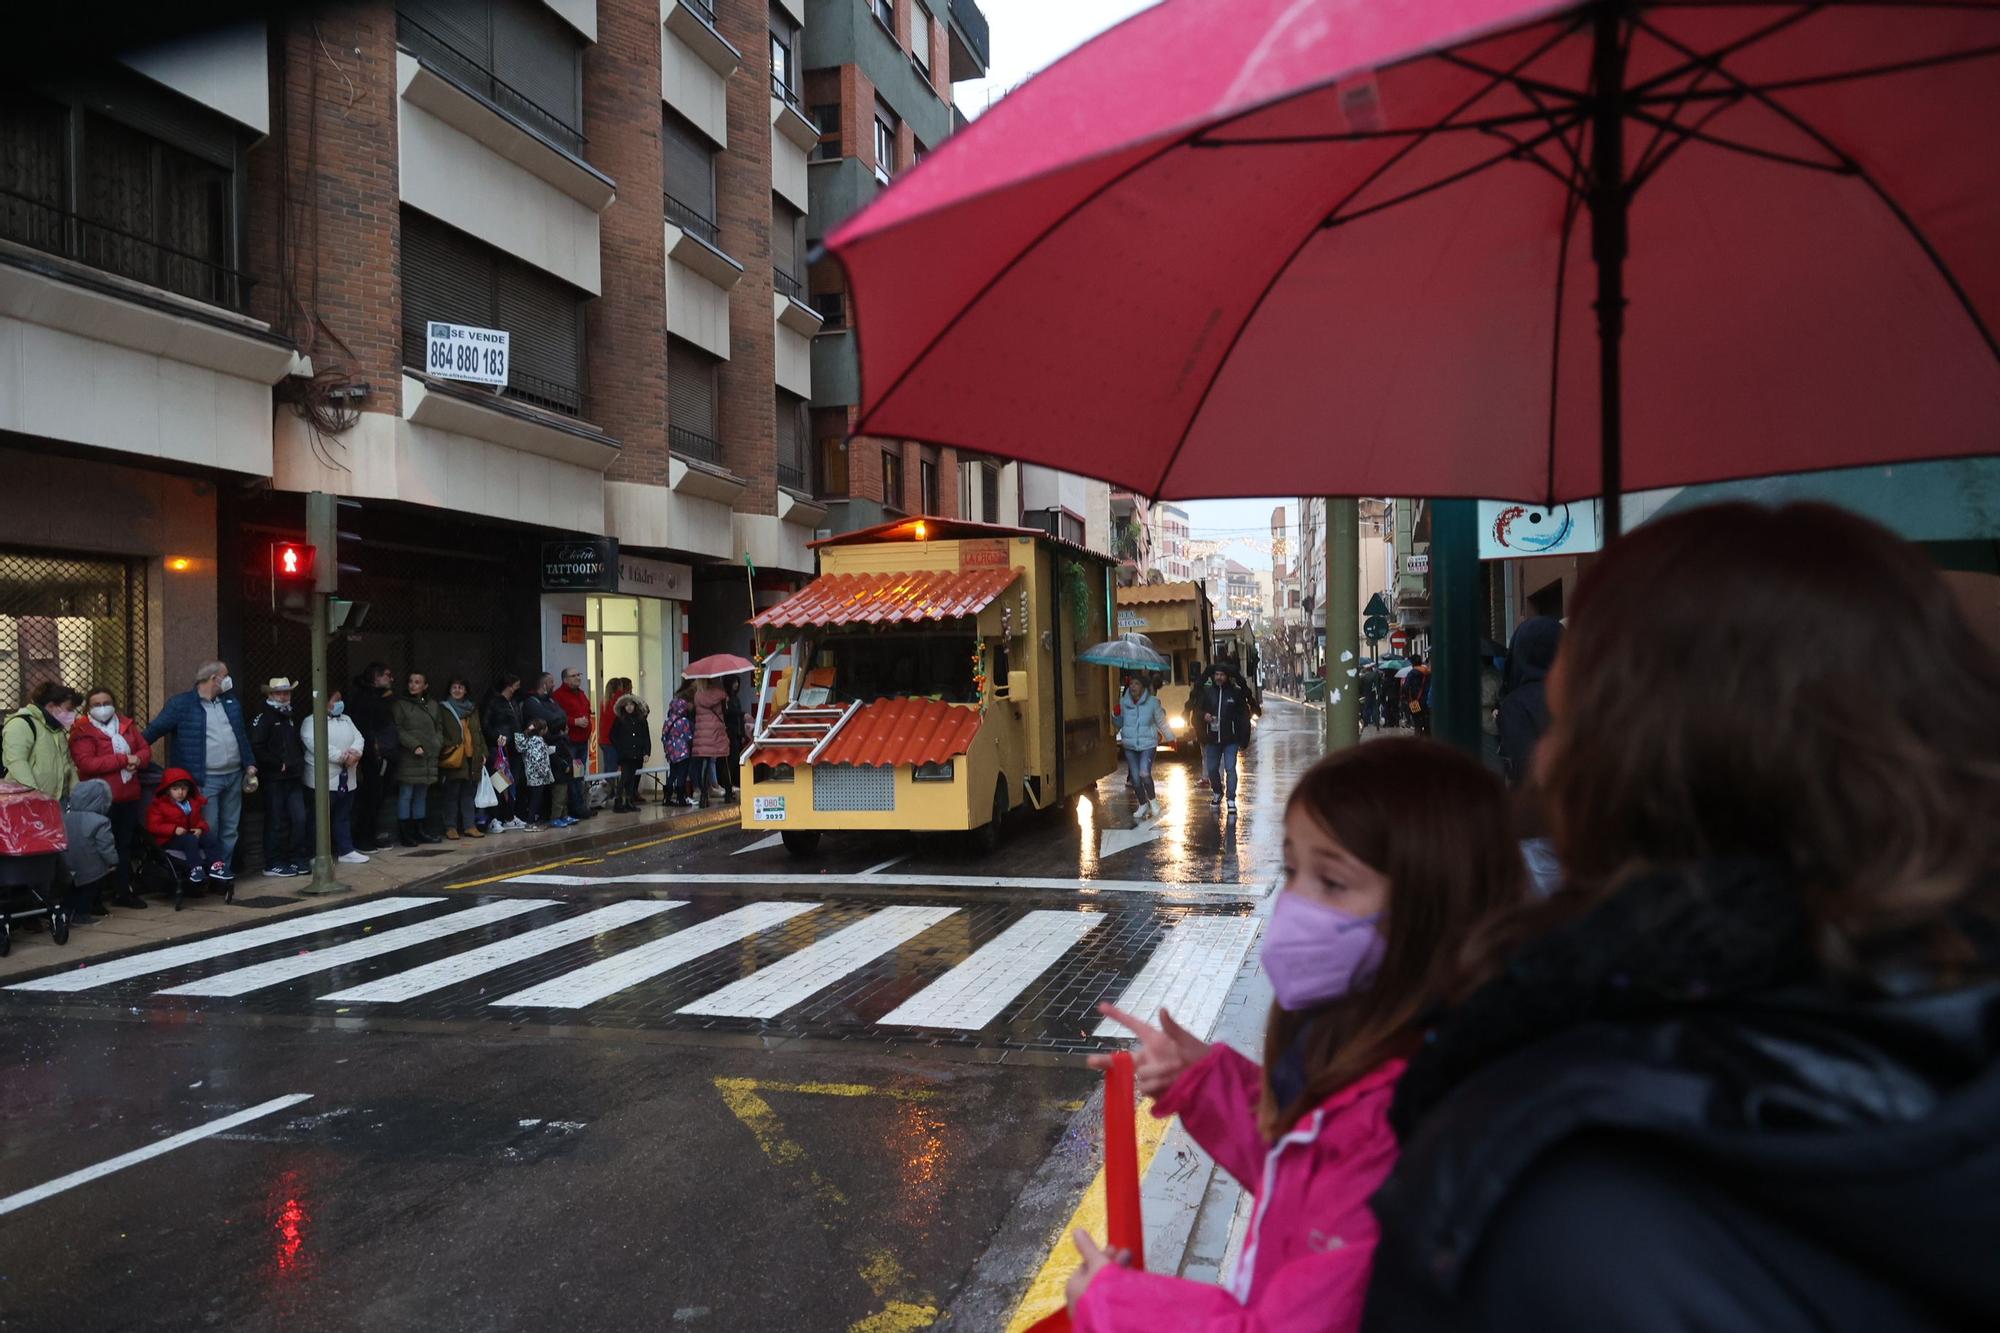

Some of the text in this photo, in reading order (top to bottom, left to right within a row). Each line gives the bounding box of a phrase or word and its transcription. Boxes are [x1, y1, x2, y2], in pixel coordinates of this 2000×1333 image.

[451, 329, 505, 344] SE VENDE
[431, 341, 504, 377] 864 880 183
[546, 562, 605, 576] TATTOOING
